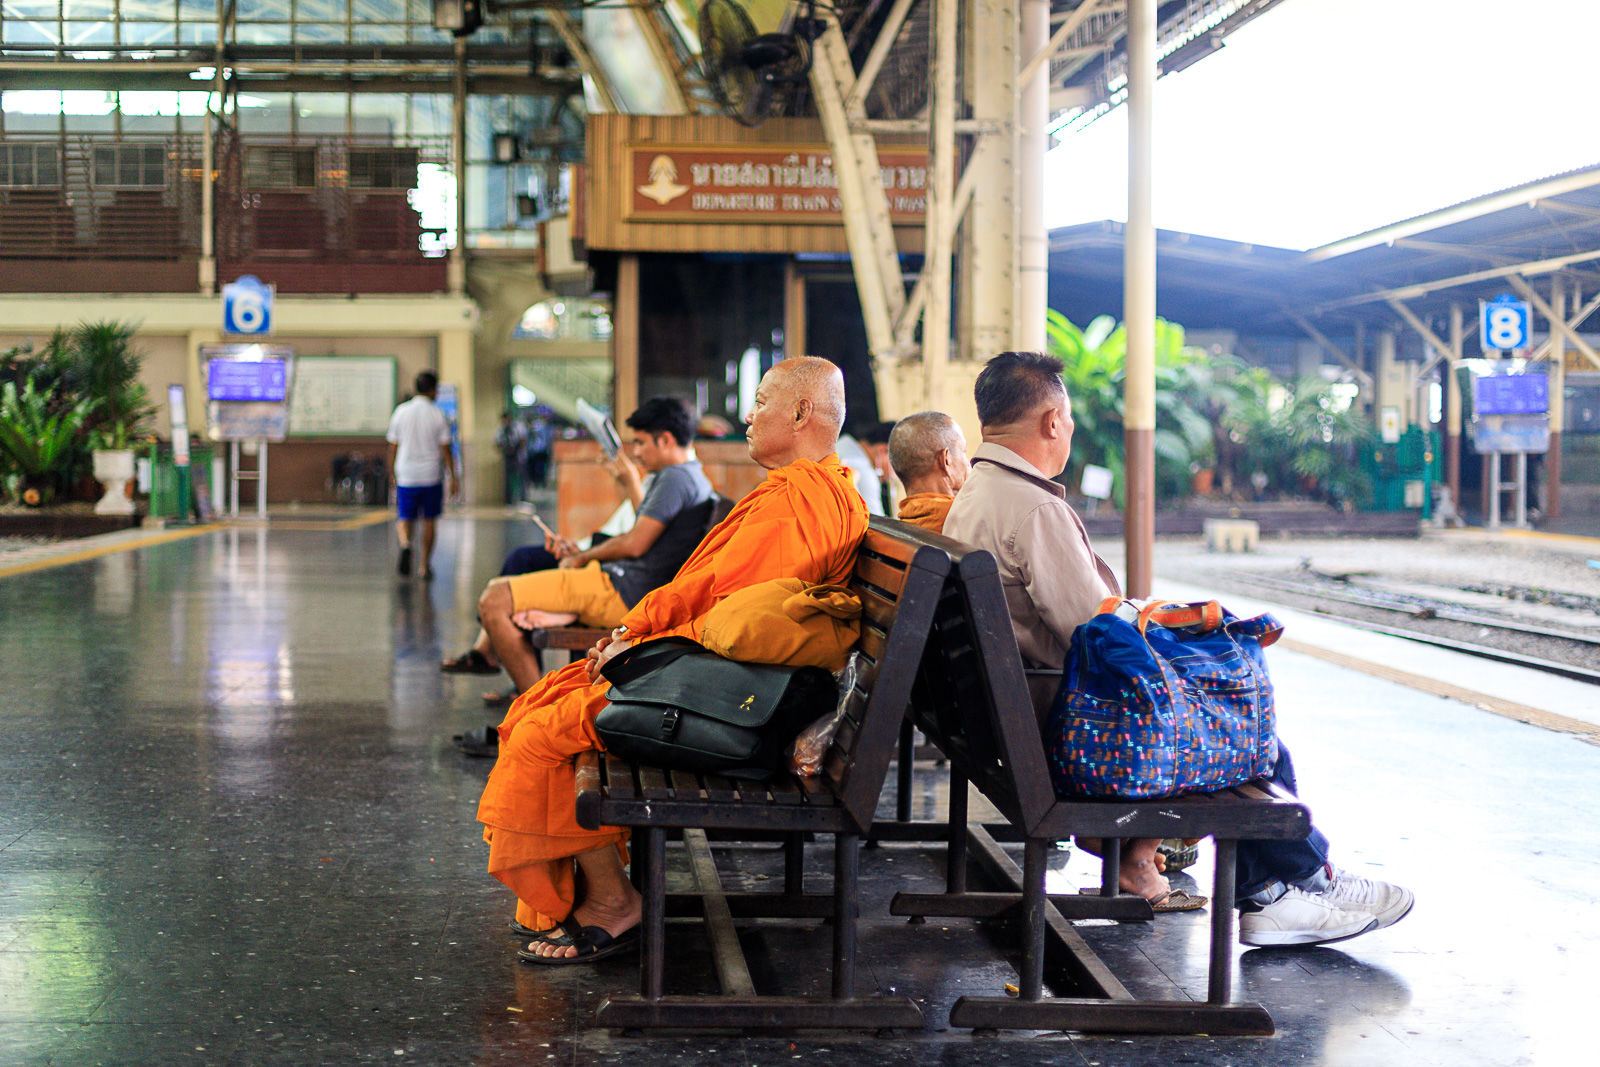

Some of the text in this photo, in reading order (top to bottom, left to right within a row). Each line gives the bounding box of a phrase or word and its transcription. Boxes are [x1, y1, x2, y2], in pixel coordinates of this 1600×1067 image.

[691, 193, 776, 211] DEPARTURE
[781, 194, 830, 212] TRAIN
[232, 292, 264, 332] 6
[1489, 307, 1523, 349] 8
